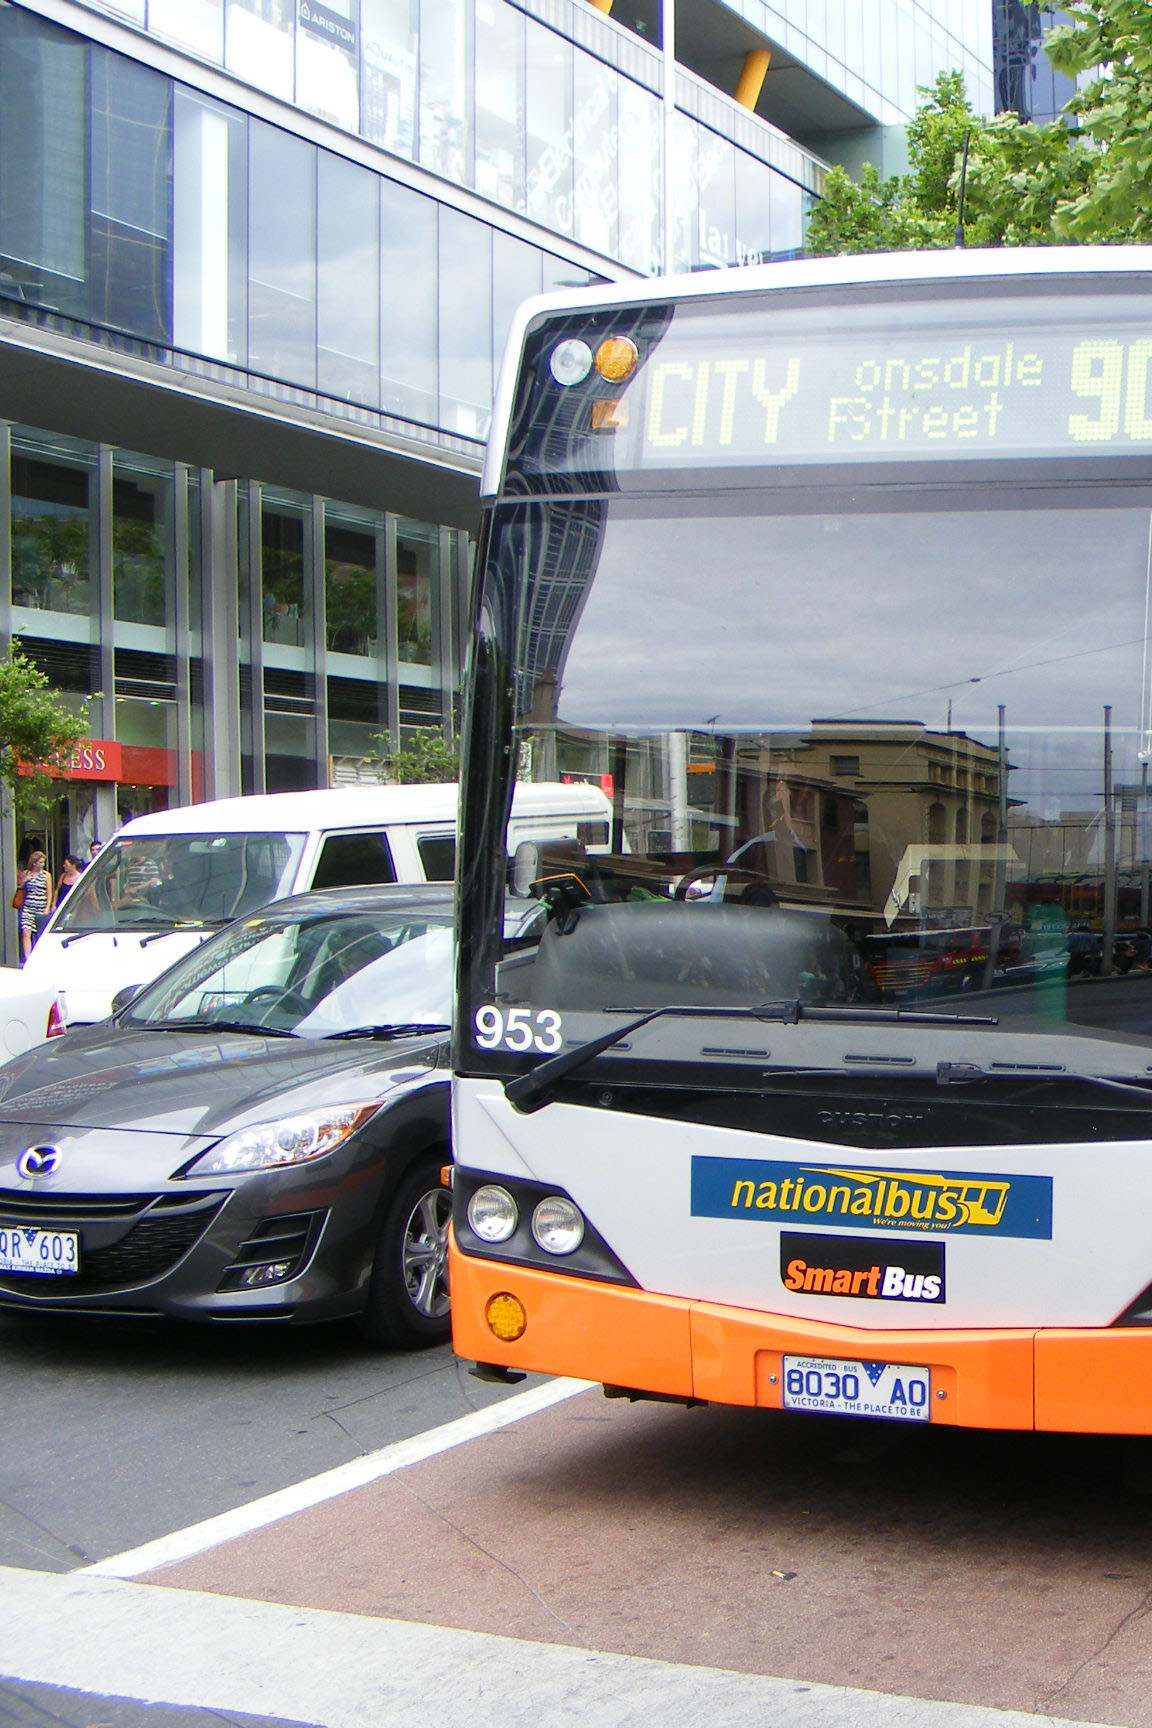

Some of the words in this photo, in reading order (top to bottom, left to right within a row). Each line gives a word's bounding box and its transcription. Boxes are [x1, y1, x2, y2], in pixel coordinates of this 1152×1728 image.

[311, 13, 356, 45] ARISTON
[648, 357, 801, 448] CITY
[475, 1004, 563, 1053] 953
[731, 1176, 960, 1222] nationalbus
[872, 1216, 897, 1227] We're
[898, 1219, 930, 1231] moving
[930, 1221, 952, 1231] you!
[40, 1234, 76, 1263] 603
[796, 1360, 837, 1371] ACCREDITED
[843, 1365, 858, 1373] BUS
[786, 1368, 859, 1401] 8030
[791, 1396, 835, 1409] VICTORIA
[844, 1401, 861, 1411] THE
[863, 1403, 893, 1414] PLACE
[896, 1406, 908, 1416] TO
[910, 1408, 922, 1417] BE
